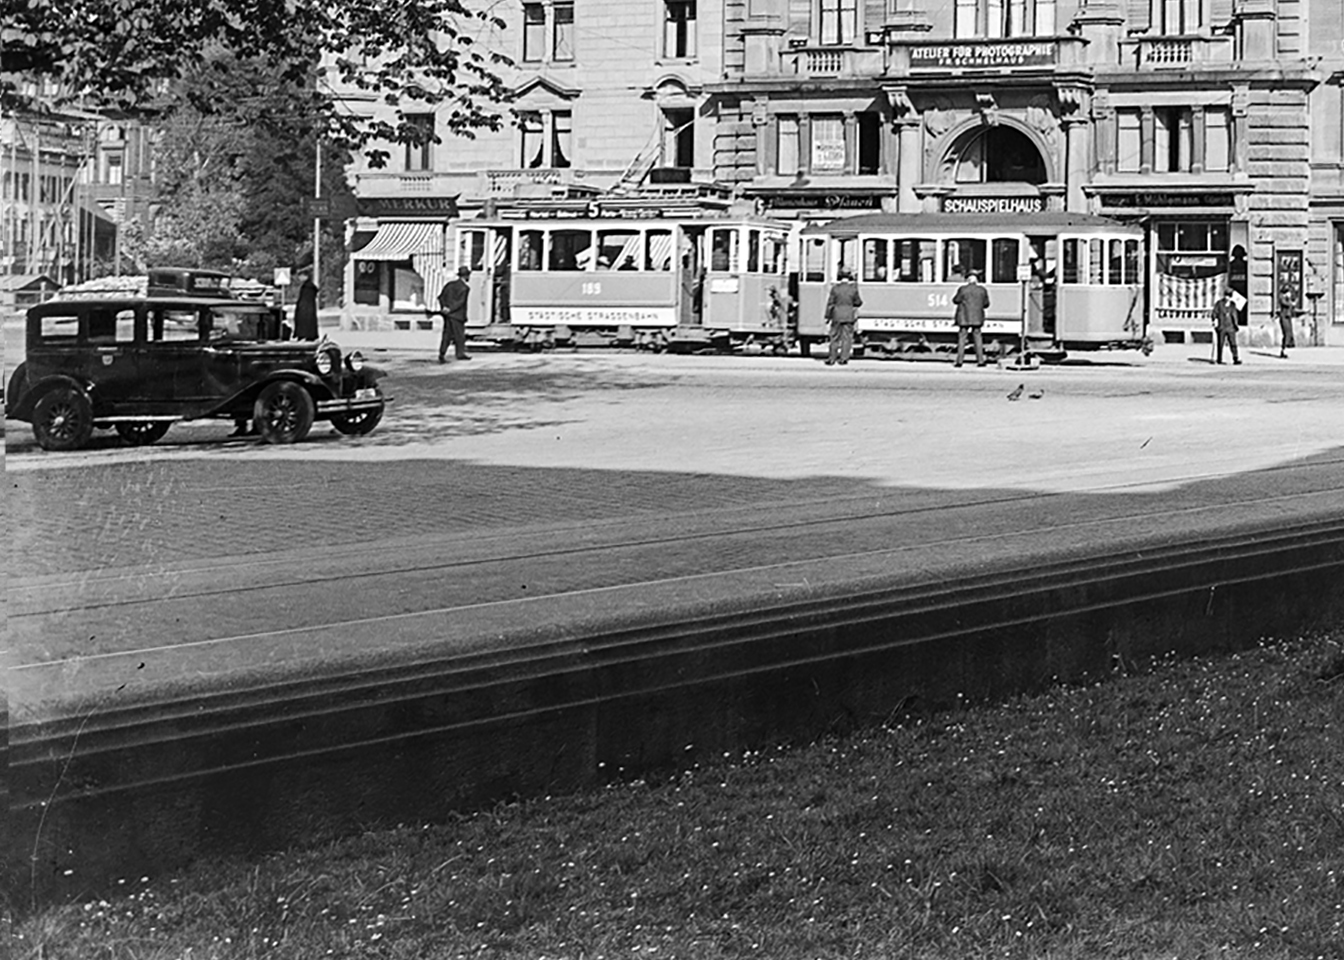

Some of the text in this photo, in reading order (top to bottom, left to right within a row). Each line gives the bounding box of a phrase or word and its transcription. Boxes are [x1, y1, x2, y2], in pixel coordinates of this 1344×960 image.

[911, 46, 950, 59] ATELIER
[974, 44, 1053, 58] PHOTOGRAPHIE
[378, 198, 452, 211] MERKUR
[588, 202, 600, 218] 5
[944, 198, 1042, 213] SCHAUSPIELHAUS
[927, 293, 949, 307] 514
